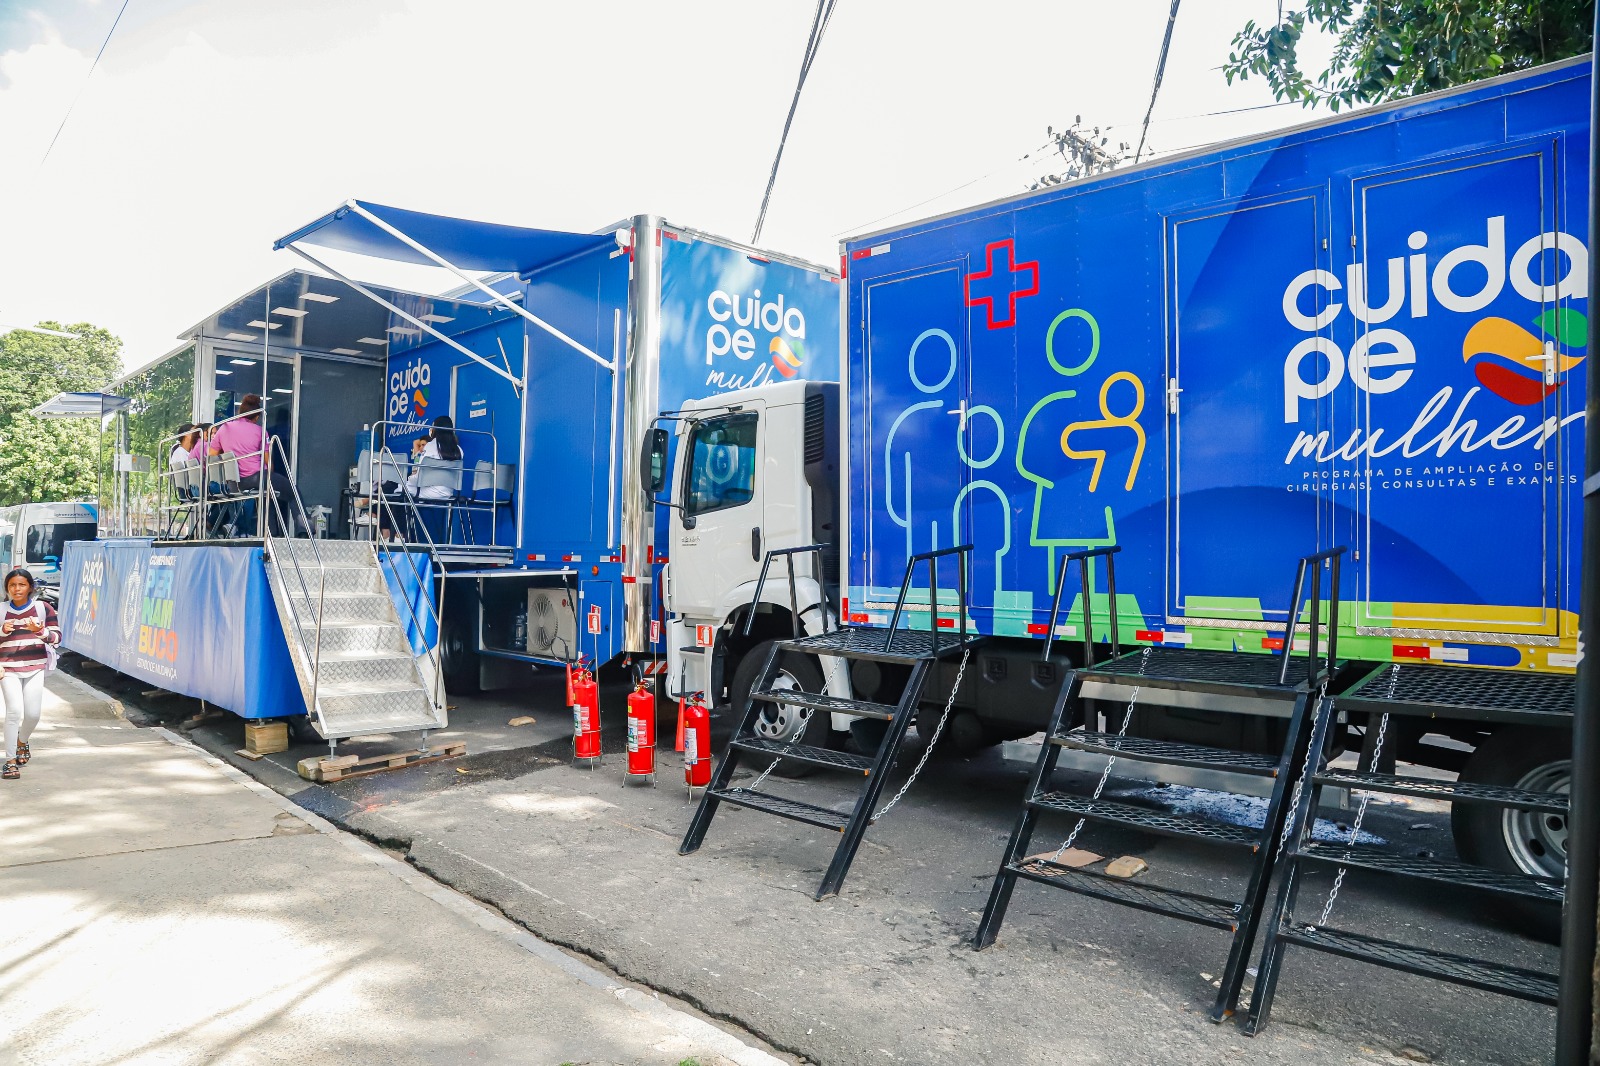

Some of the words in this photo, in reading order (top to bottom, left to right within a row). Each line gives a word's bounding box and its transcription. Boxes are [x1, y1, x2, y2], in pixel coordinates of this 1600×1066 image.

[1283, 215, 1588, 332] cuida
[707, 288, 806, 340] cuida
[706, 324, 756, 366] pe
[391, 358, 431, 393] cuida
[706, 362, 774, 390] mulh
[1284, 328, 1416, 424] pe
[389, 392, 409, 422] pe
[1285, 386, 1586, 465] mulher
[1303, 469, 1384, 480] PROGRAMA
[1394, 466, 1413, 476] DE
[1423, 461, 1523, 475] AMPLIAÇÃO
[1534, 461, 1555, 471] DE
[1382, 477, 1478, 489] CONSULTAS
[1488, 476, 1495, 487] E
[1506, 474, 1578, 486] EXAMES
[145, 569, 174, 600] PER
[142, 596, 174, 630] NAM
[139, 625, 178, 663] BUCO
